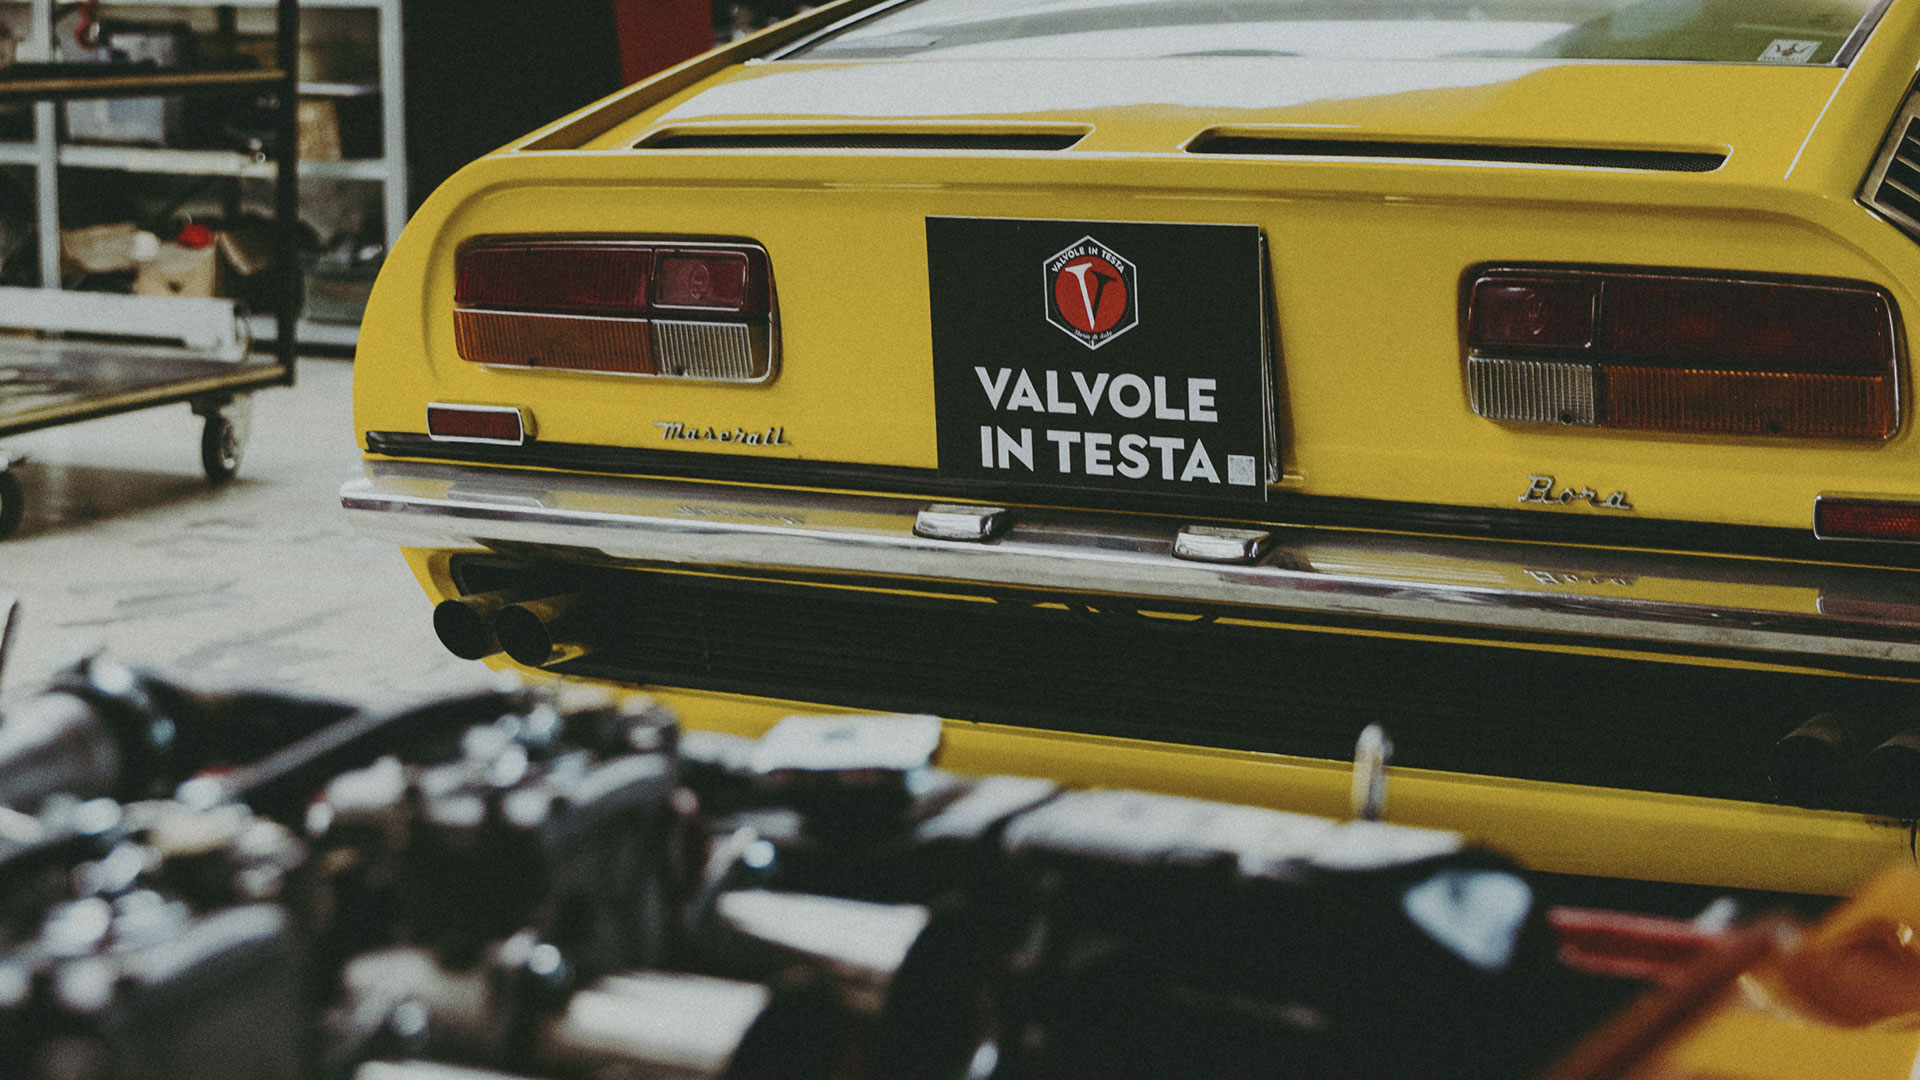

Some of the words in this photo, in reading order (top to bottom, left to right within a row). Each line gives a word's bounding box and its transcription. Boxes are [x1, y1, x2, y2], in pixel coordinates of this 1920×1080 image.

[1051, 246, 1085, 273] VALVOLE
[1088, 246, 1098, 255] IN
[1101, 249, 1125, 274] TESTA
[975, 366, 1218, 422] VALVOLE
[980, 425, 1034, 472] IN
[1046, 429, 1221, 484] TESTA
[1518, 474, 1634, 510] Bora
